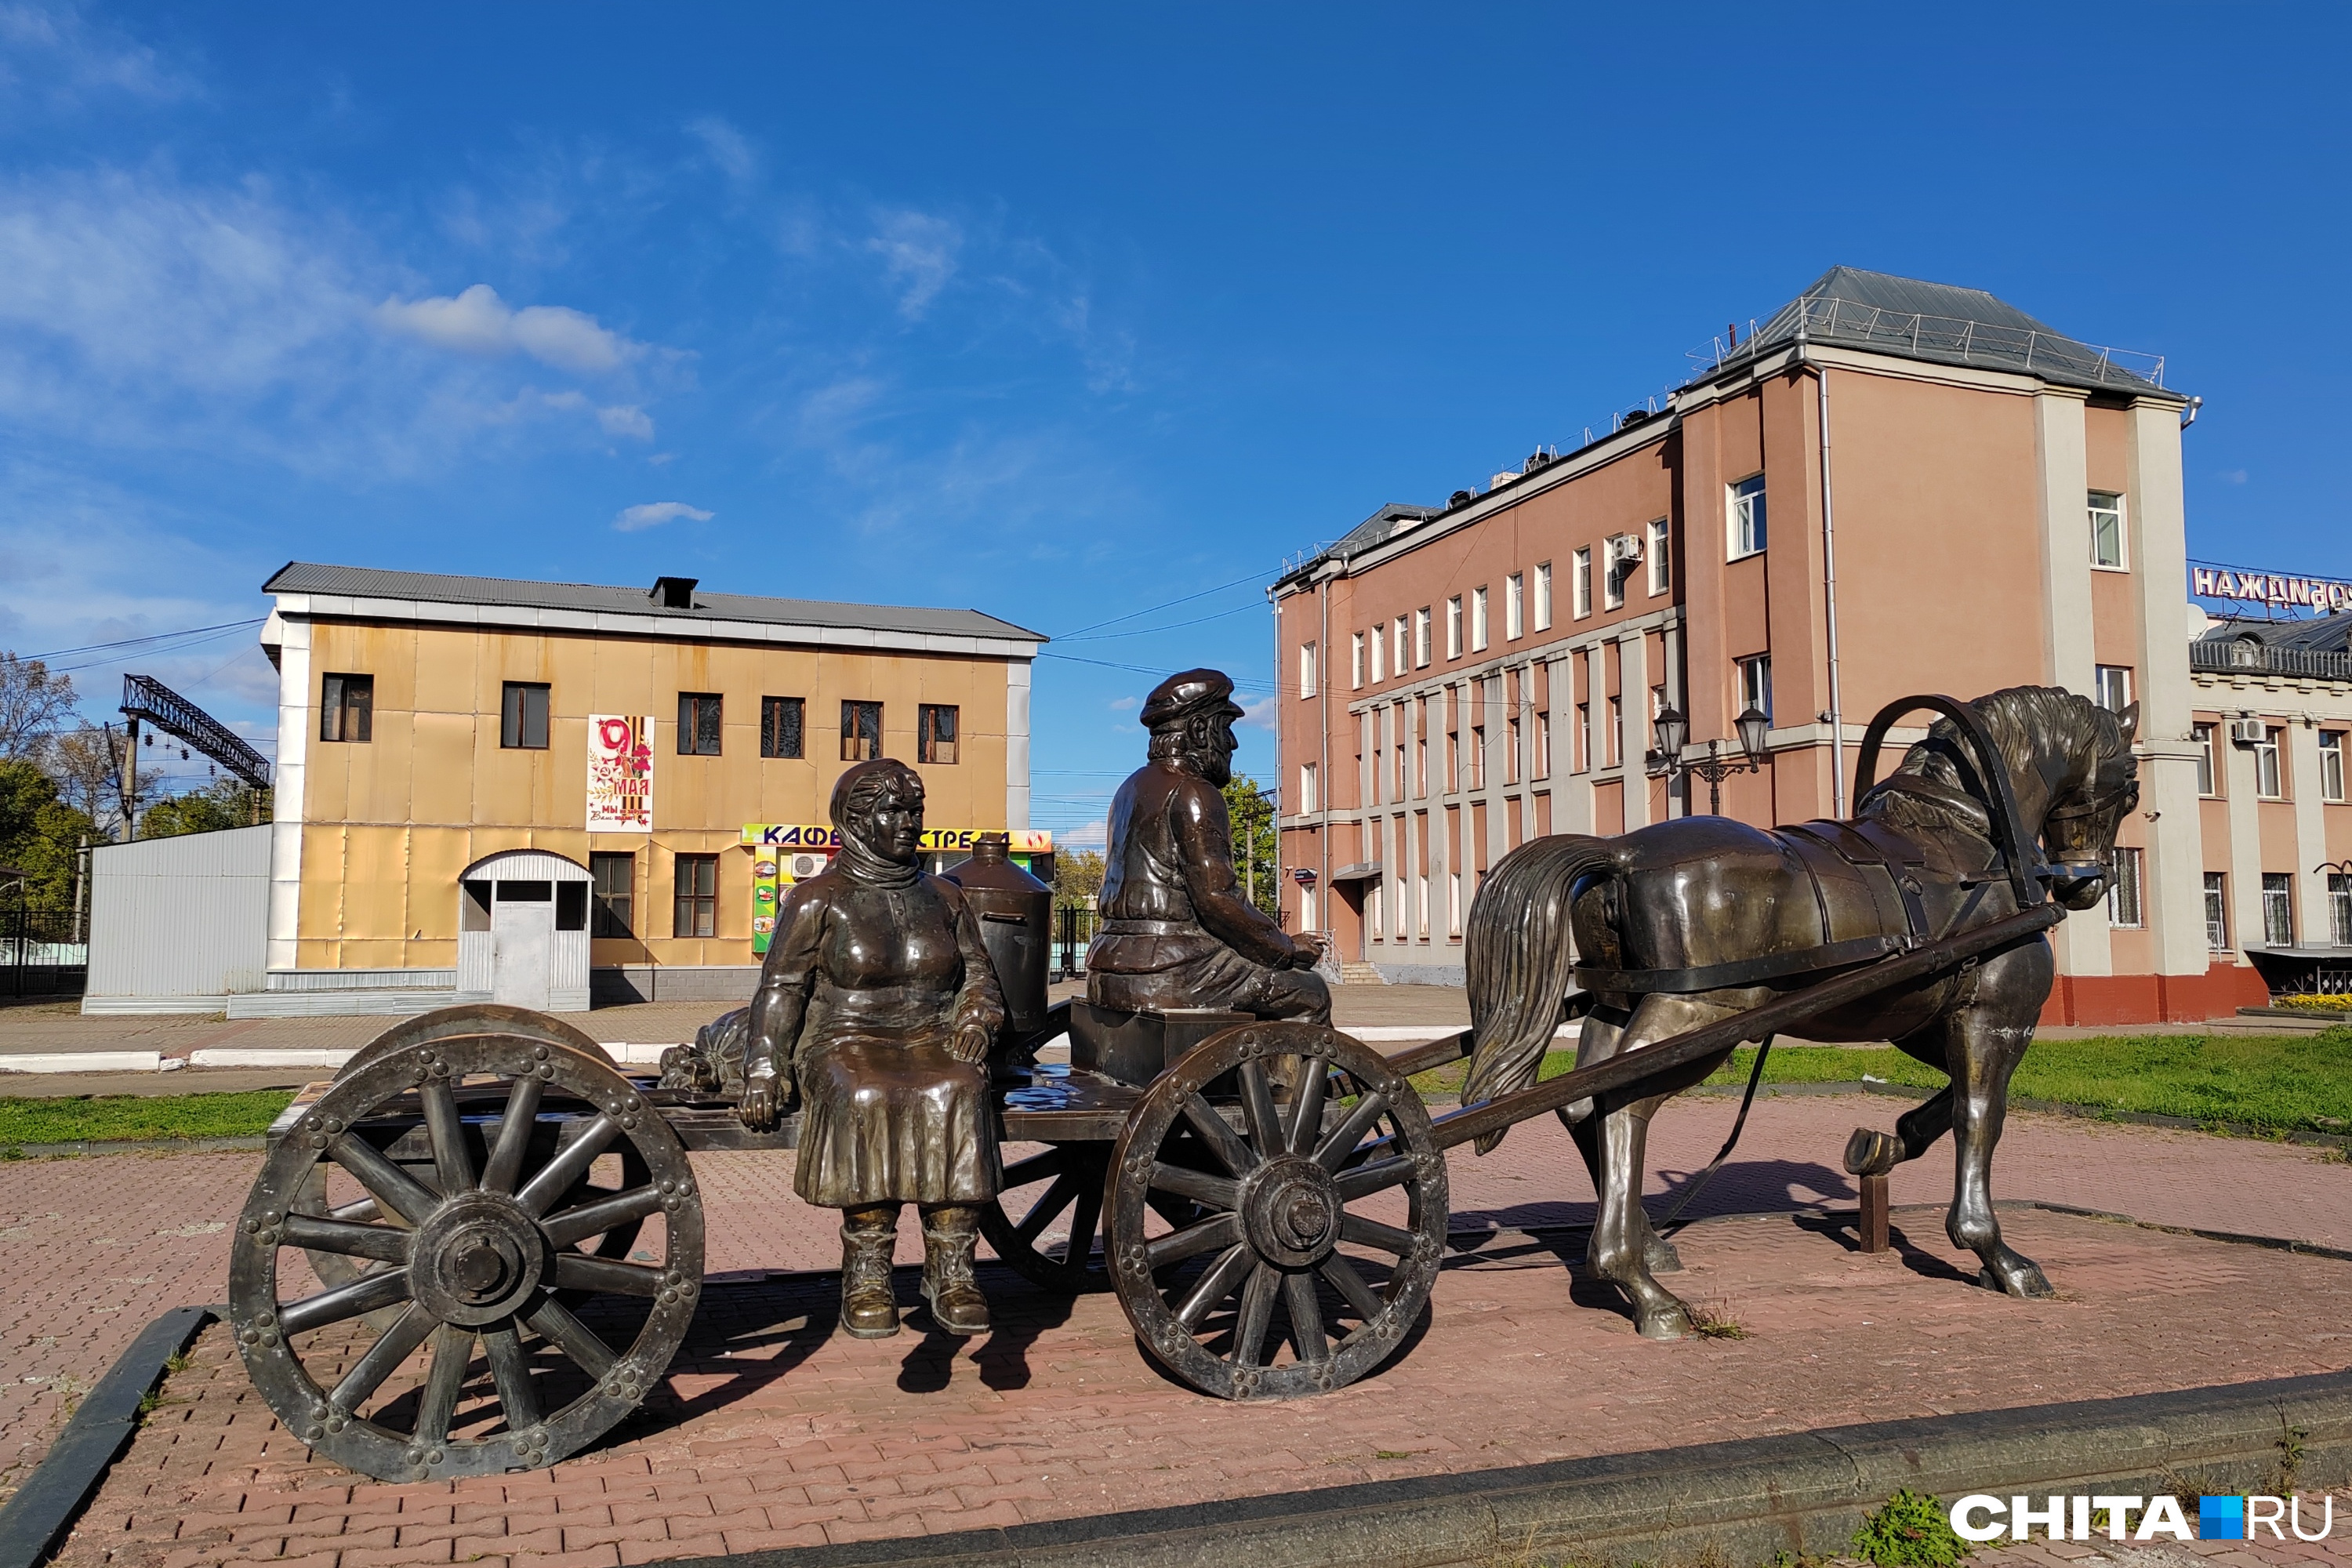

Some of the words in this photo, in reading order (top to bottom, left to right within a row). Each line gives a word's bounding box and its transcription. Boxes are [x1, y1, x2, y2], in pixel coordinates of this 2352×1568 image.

[598, 718, 633, 767] 9
[614, 779, 649, 796] МАЯ
[602, 805, 618, 814] МЫ
